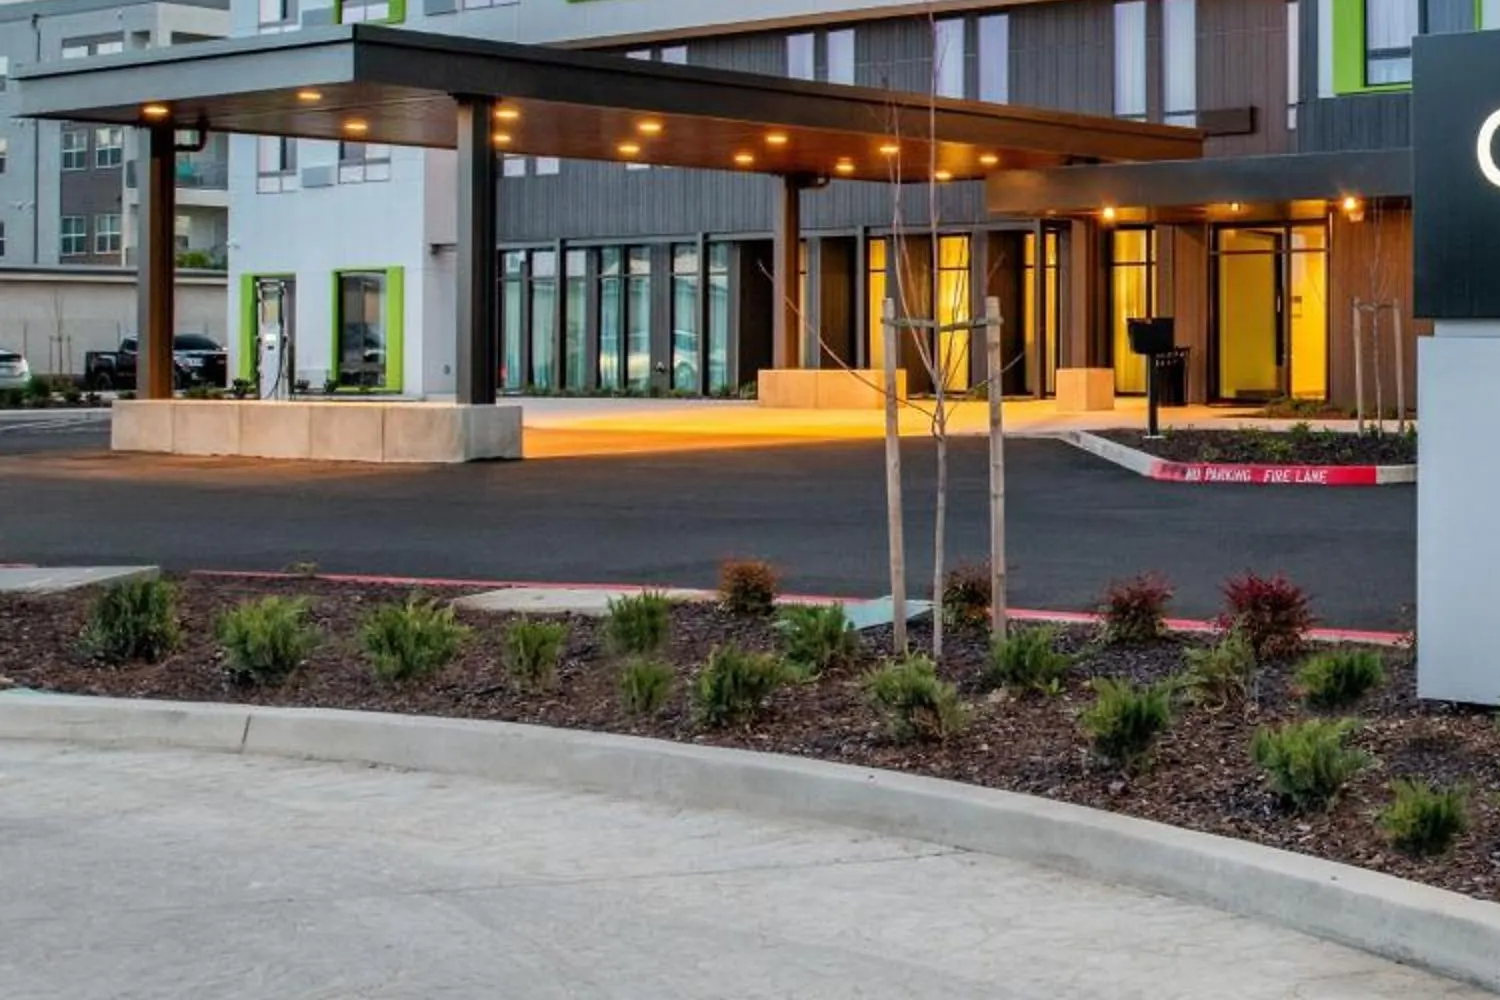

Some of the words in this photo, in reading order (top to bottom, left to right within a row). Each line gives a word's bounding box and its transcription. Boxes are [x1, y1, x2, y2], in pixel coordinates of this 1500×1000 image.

[1185, 467, 1201, 482] NO
[1204, 467, 1252, 483] PARKING
[1263, 468, 1291, 483] FIRE
[1295, 469, 1329, 485] LANE
